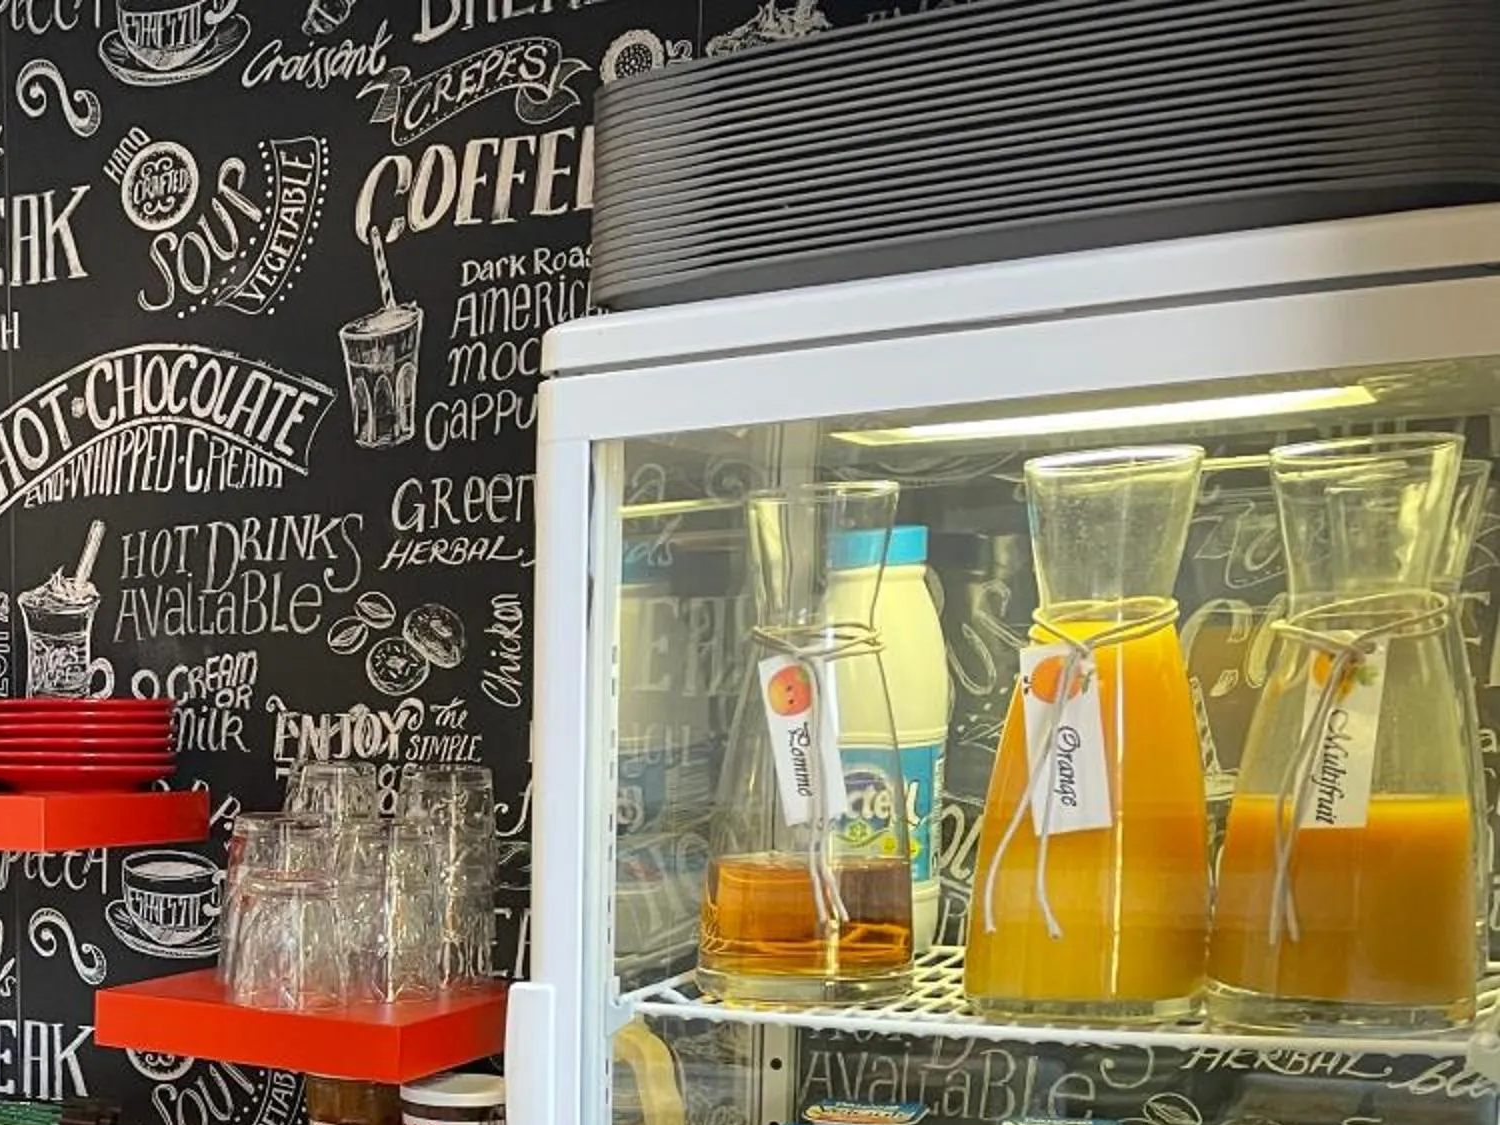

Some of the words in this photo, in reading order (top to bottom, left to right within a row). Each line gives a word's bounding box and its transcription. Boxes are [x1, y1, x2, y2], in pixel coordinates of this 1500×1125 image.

[242, 18, 393, 89] Croissant
[404, 45, 548, 130] CREPES
[137, 157, 262, 311] SOUP
[237, 150, 315, 304] VEGETABLE
[85, 353, 319, 456] CHOCOLATE
[120, 524, 199, 581] HOT
[202, 513, 363, 594] DRINKS
[380, 536, 524, 571] HERBAL
[215, 687, 253, 710] OR
[266, 696, 425, 763] ENJOY
[431, 696, 469, 731] the
[406, 734, 484, 763] SIMPLE
[1053, 725, 1081, 808] Orange
[1311, 708, 1354, 826] Multifruit
